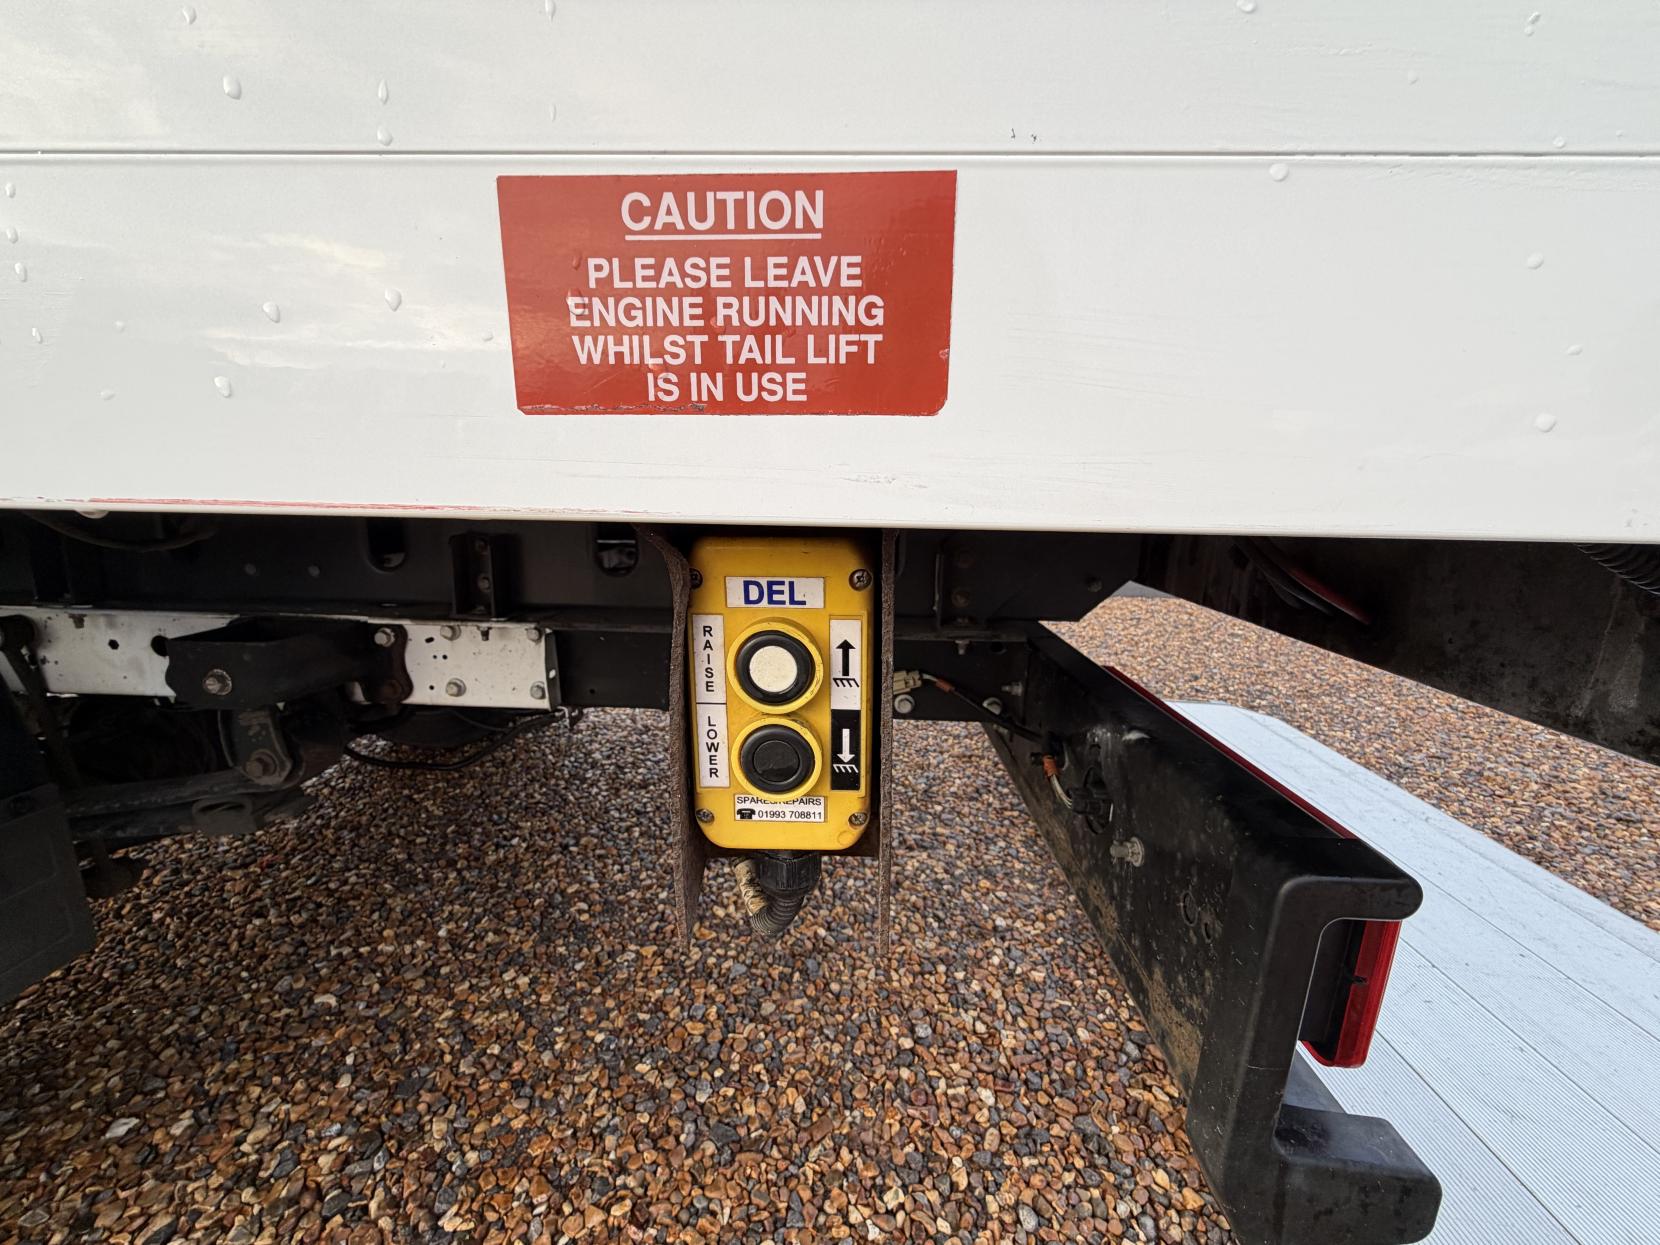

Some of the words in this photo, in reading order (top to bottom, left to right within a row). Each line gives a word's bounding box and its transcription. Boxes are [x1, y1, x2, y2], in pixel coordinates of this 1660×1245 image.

[620, 189, 824, 232] CAUTION
[587, 256, 732, 290] PLEASE
[744, 254, 863, 289] LEAVE
[568, 296, 705, 328] ENGINE
[716, 294, 885, 328] RUNNING
[571, 334, 709, 366] WHILST
[717, 333, 796, 365] TAIL
[806, 333, 883, 365] LIFT
[647, 372, 679, 402] IS
[690, 372, 724, 402] IN
[735, 371, 808, 402] USE
[742, 579, 807, 606] DEL
[702, 625, 715, 693] RAISE
[705, 715, 720, 778] LOWER
[757, 810, 786, 819] 01993
[789, 810, 822, 820] 708811
